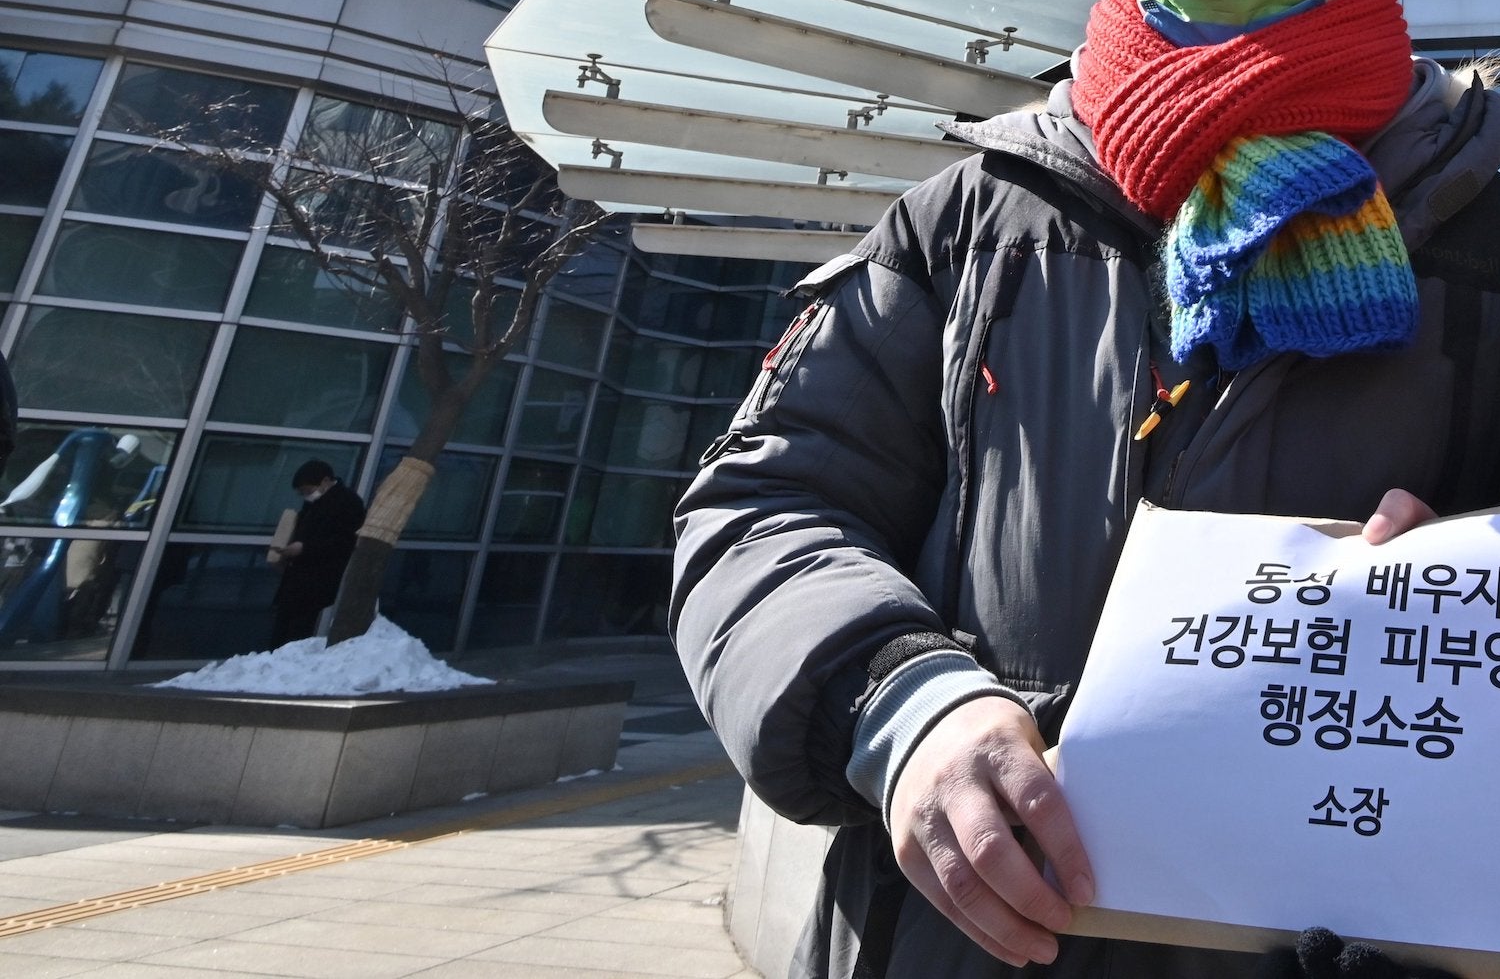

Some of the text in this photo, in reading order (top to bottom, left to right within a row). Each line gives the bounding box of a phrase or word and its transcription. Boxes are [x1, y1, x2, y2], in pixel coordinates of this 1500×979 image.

[1245, 562, 1339, 606] 동성
[1162, 614, 1352, 676] 건강보험
[1259, 683, 1464, 760] 행정소송
[1307, 785, 1390, 837] 소장
